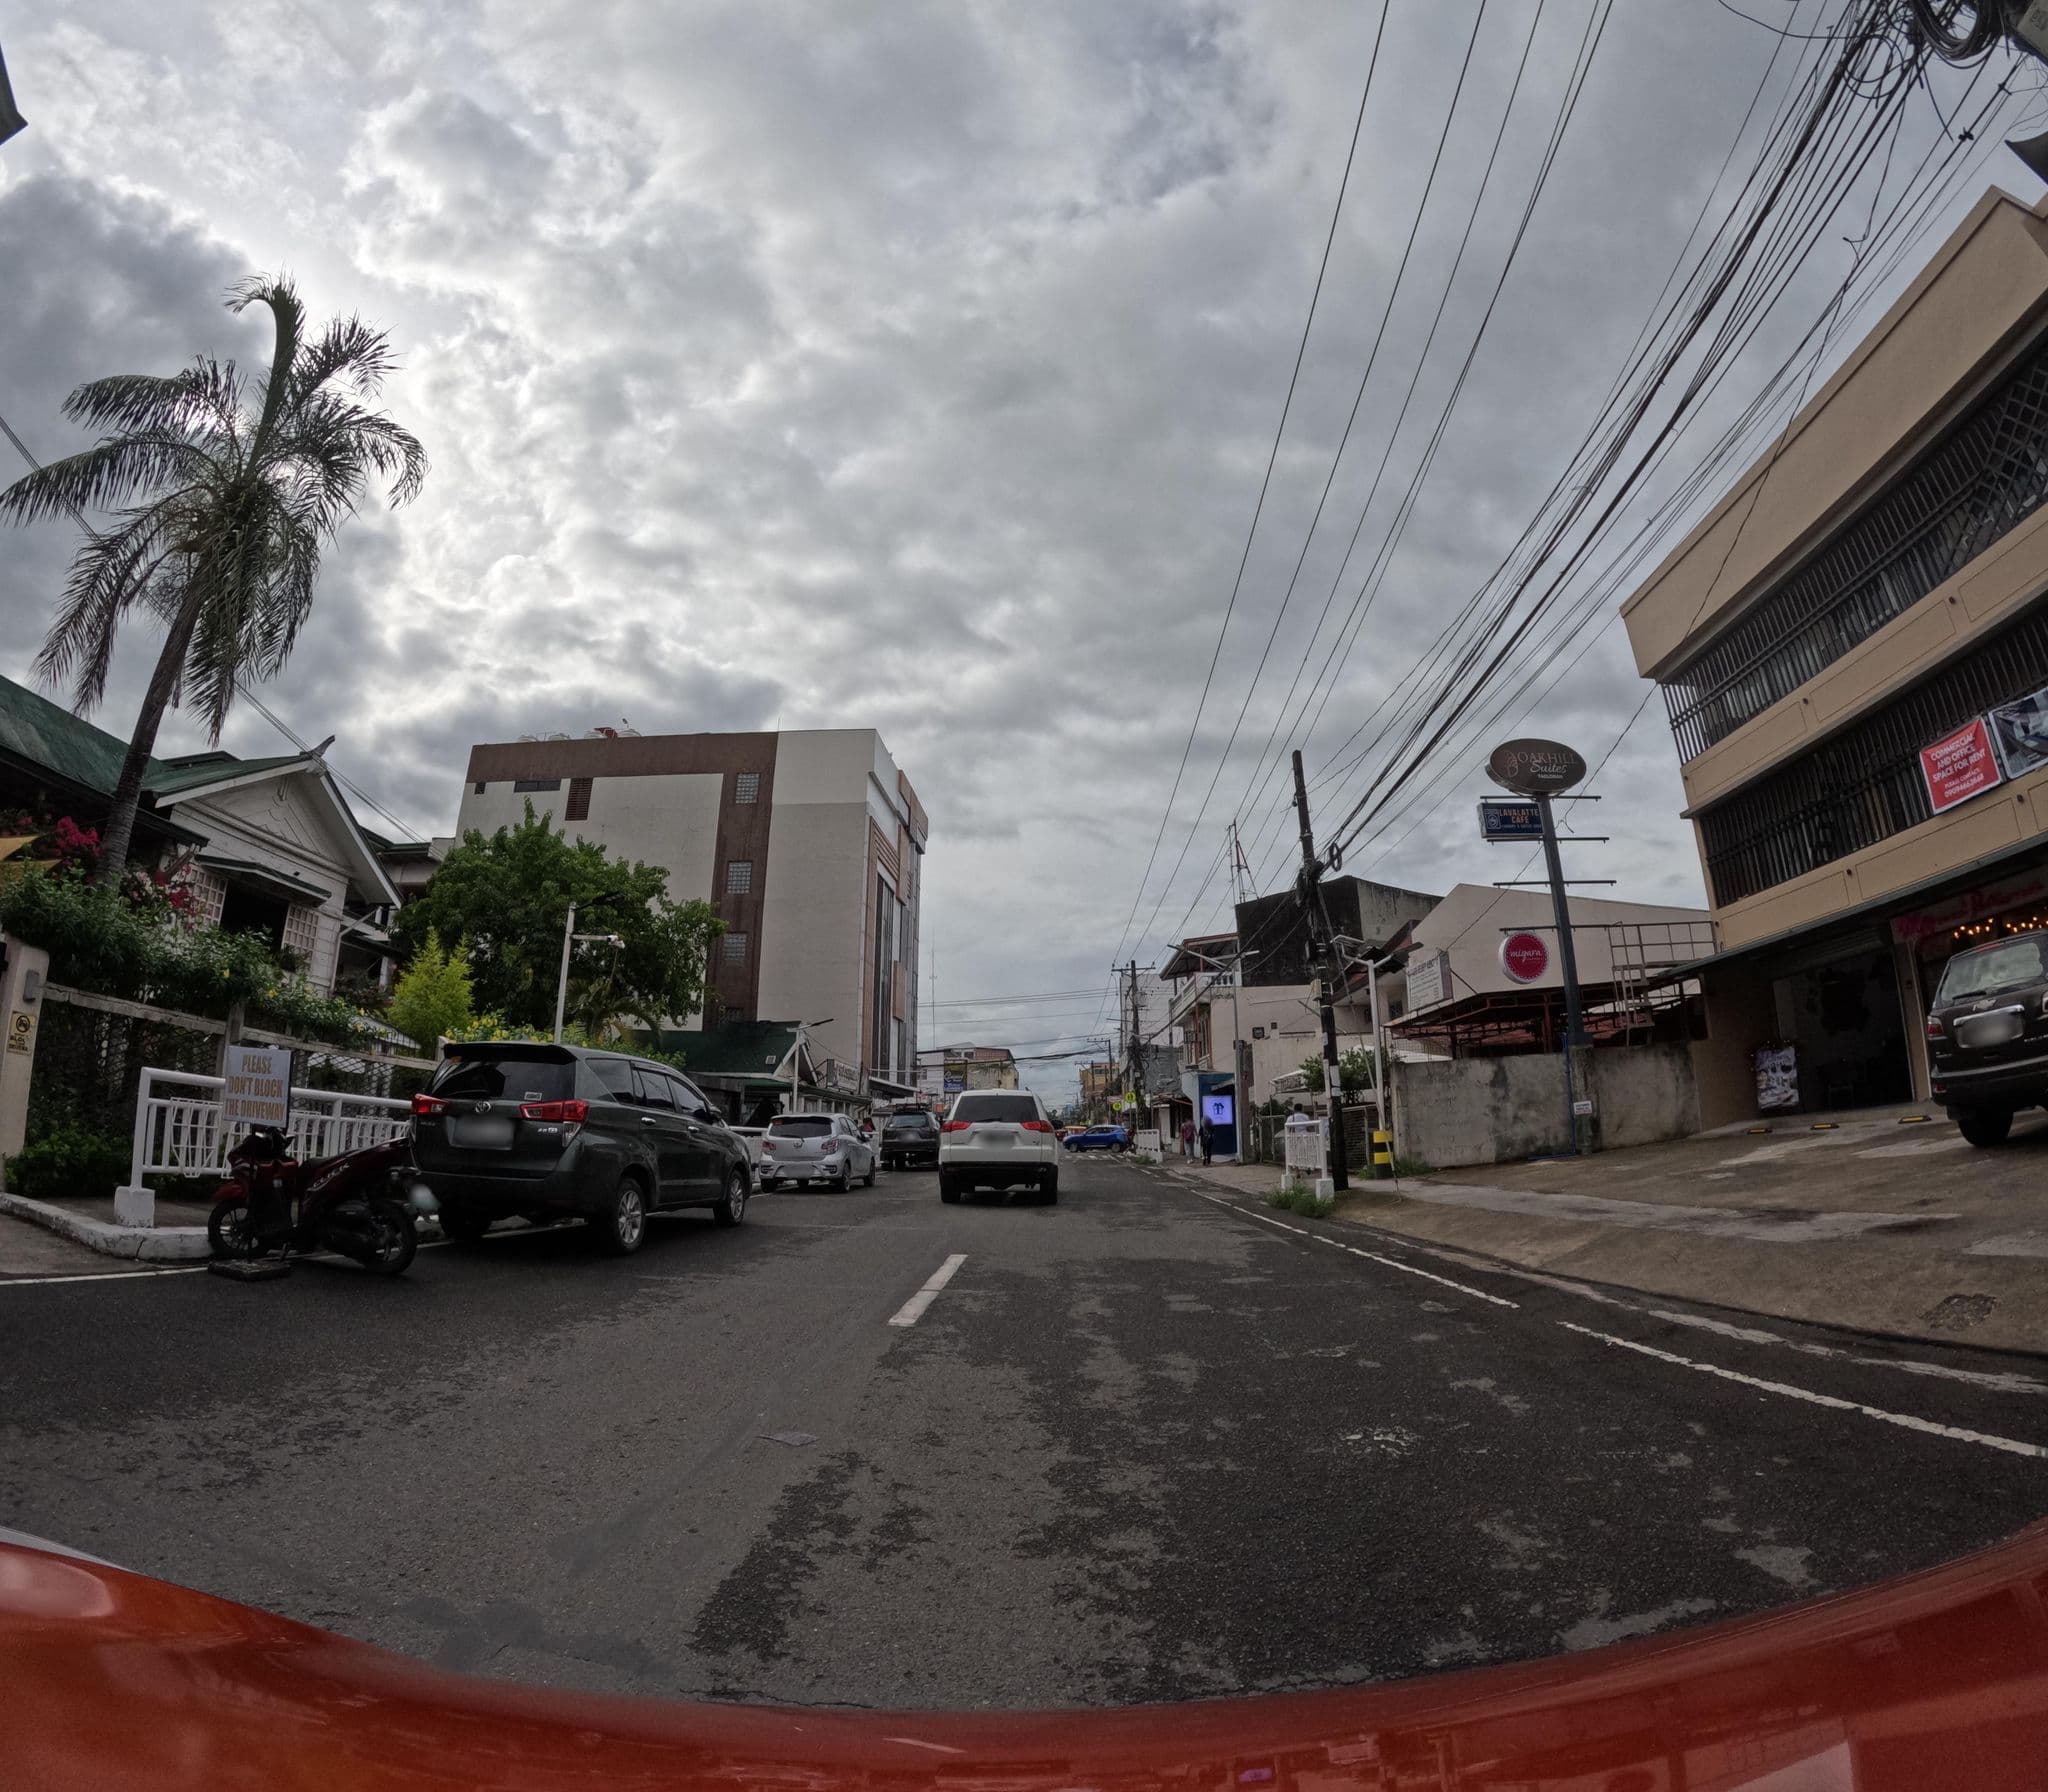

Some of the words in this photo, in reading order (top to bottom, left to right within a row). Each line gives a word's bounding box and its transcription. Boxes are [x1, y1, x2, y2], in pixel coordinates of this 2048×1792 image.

[1931, 733, 1974, 760] COMMERCIAL
[1937, 756, 1952, 769] AND
[1952, 744, 1975, 761] OFFICE
[1530, 760, 1567, 774] Suites
[1933, 766, 1955, 783] SPACE
[1954, 759, 1969, 772] FOR
[1969, 748, 1985, 764] RENT
[1511, 815, 1530, 824] CAFE
[242, 1055, 272, 1074] PLEASE
[255, 1078, 283, 1097] BLOCK
[225, 1098, 240, 1116] THE
[240, 1100, 285, 1120] DRIVEWAY
